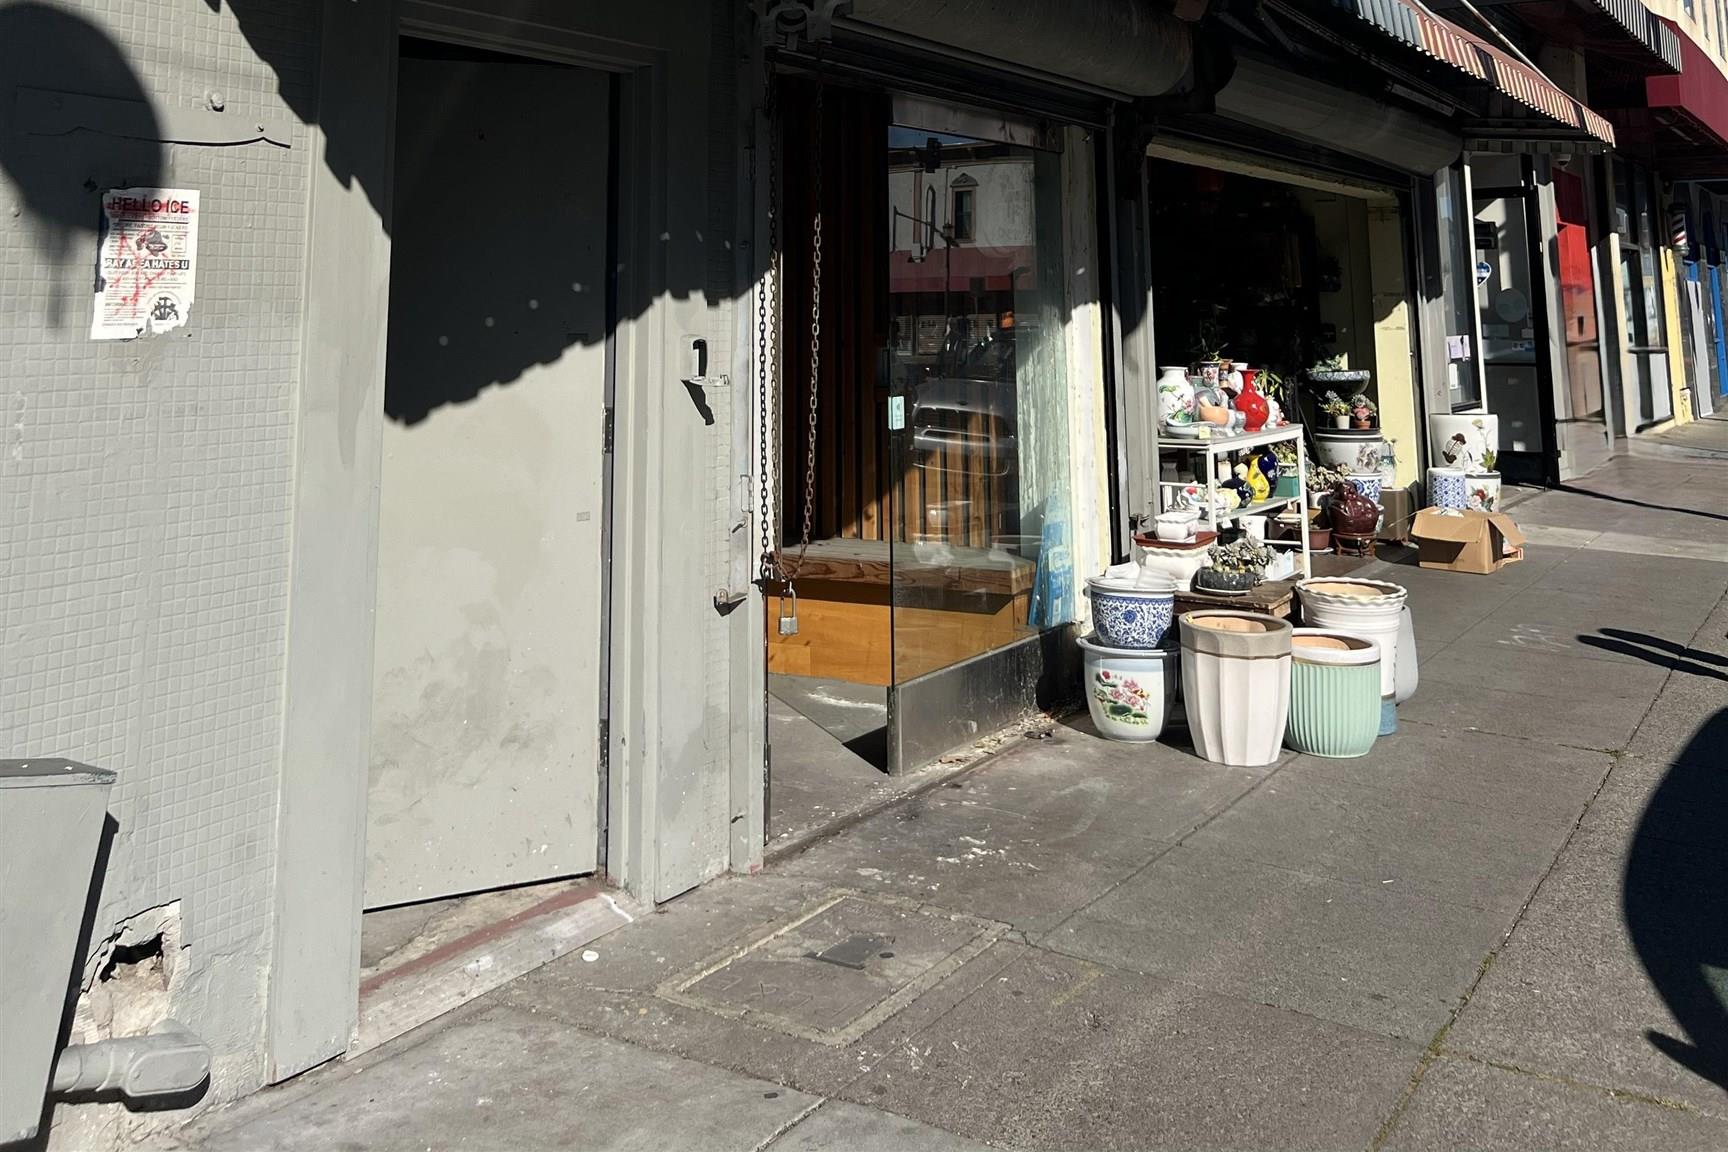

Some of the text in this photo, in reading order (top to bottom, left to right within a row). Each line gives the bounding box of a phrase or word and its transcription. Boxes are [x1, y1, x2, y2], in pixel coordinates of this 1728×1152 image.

[165, 199, 190, 214] ICE
[104, 257, 125, 269] BAY
[151, 258, 180, 269] HATES
[180, 259, 189, 270] U
